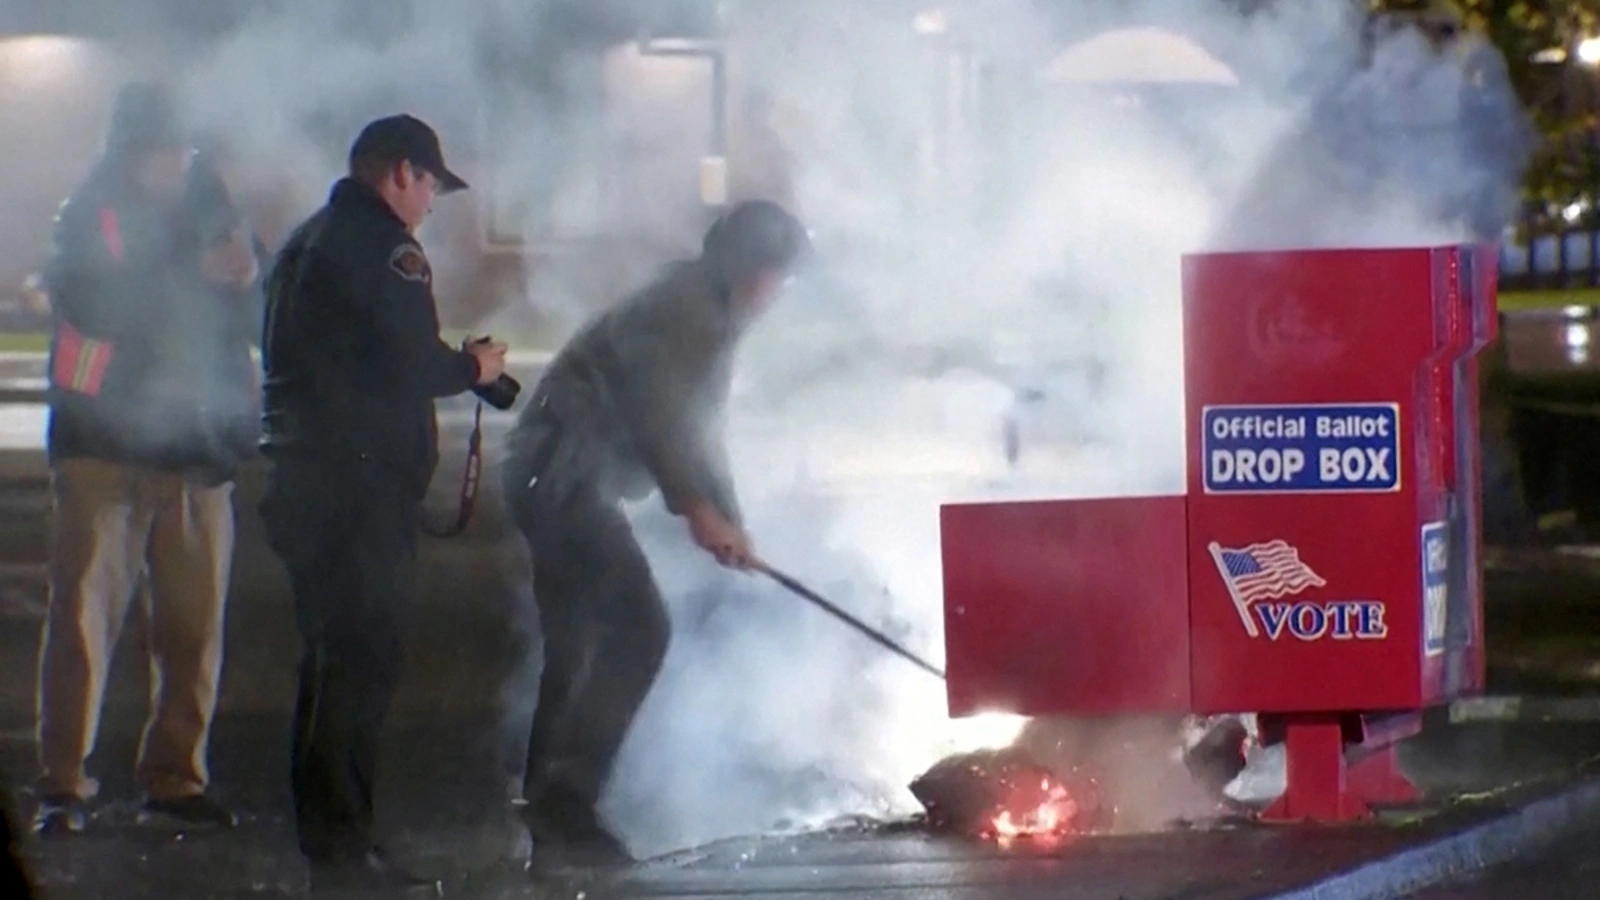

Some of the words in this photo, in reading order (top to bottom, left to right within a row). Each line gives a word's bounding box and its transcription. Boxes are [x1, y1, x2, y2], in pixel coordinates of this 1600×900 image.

[1213, 416, 1305, 438] Official
[1316, 415, 1389, 437] Ballot
[1211, 449, 1304, 482] DROP
[1319, 447, 1390, 481] BOX
[1255, 602, 1388, 640] VOTE
